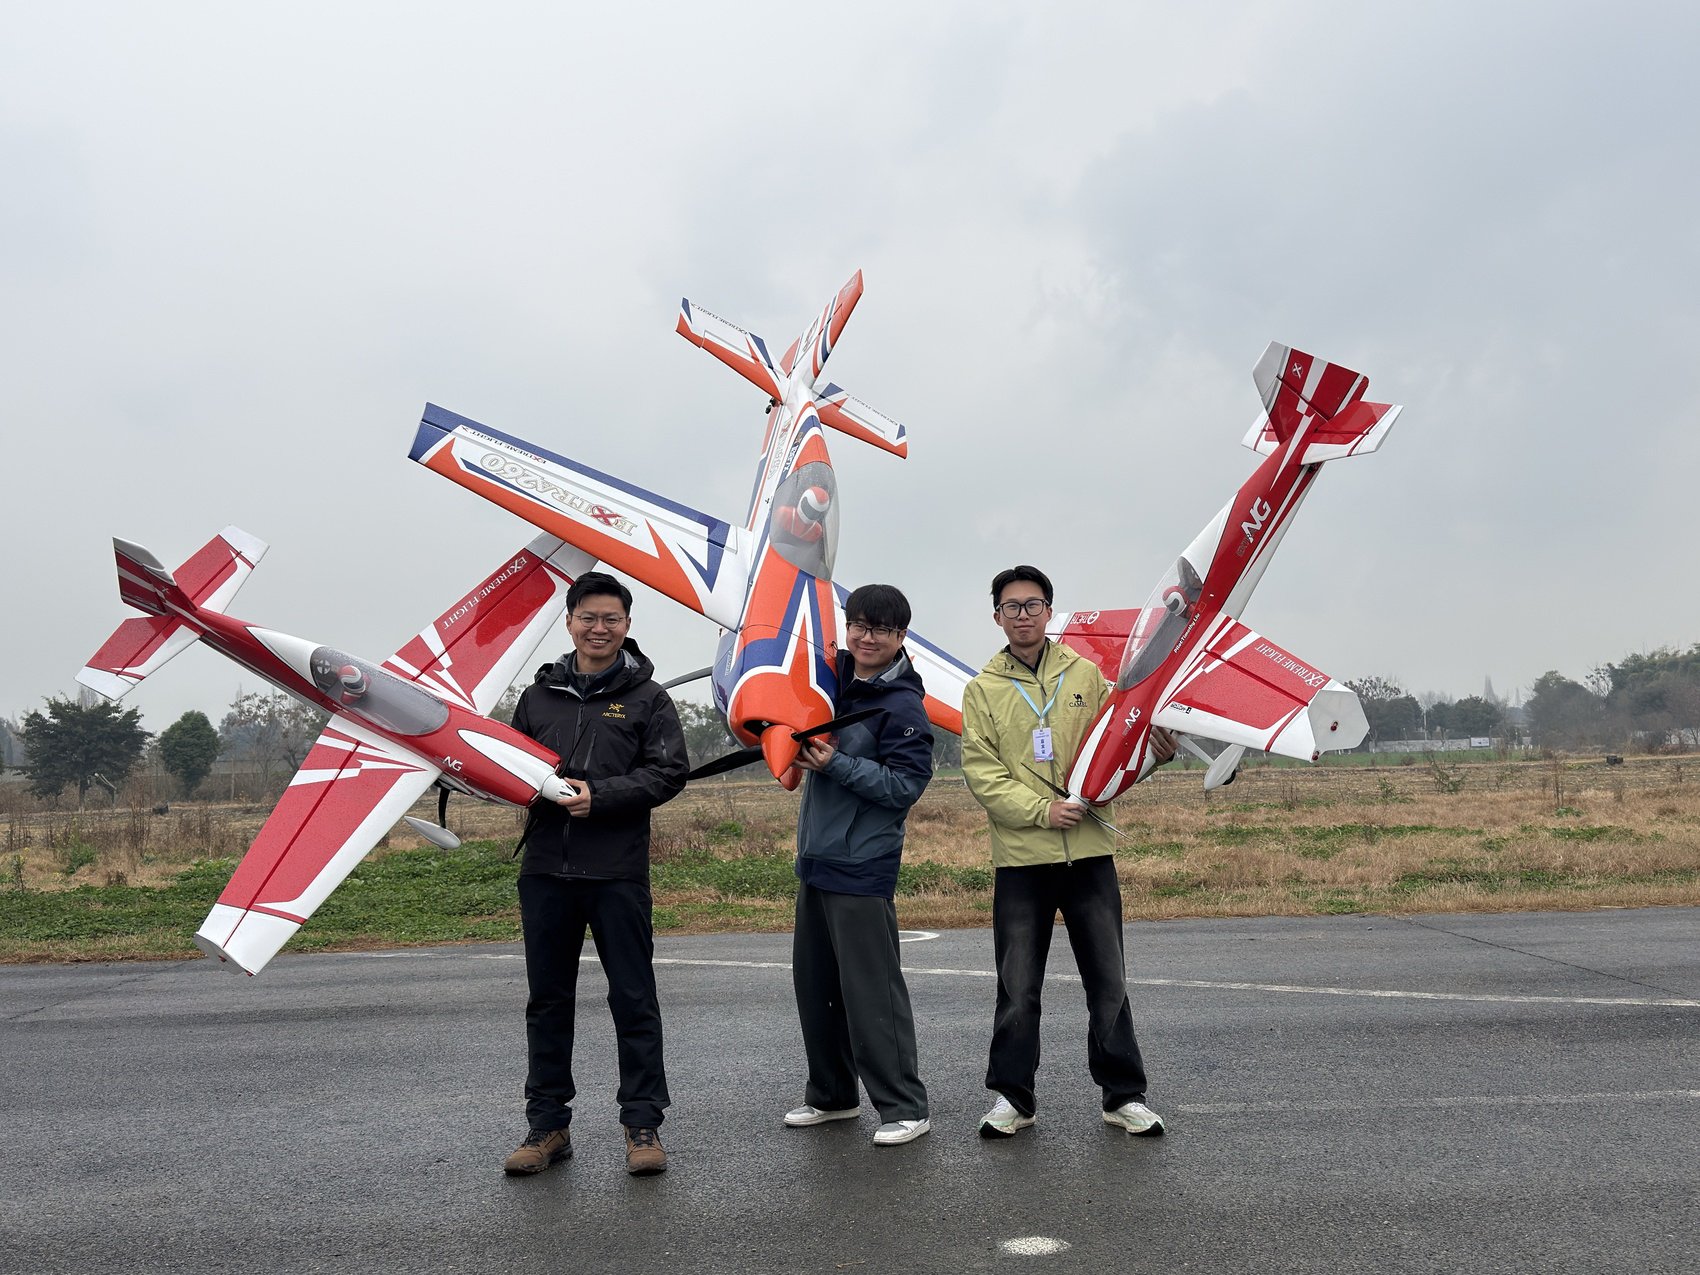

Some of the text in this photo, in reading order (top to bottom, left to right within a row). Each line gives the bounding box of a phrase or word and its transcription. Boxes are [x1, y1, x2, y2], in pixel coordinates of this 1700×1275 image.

[470, 429, 504, 447] FLIGHT
[504, 443, 546, 465] EXTREME
[480, 452, 638, 537] EXTRA260
[1241, 496, 1272, 544] NG
[443, 556, 528, 630] EXTREME FLIGHT
[1255, 643, 1326, 689] EXTREME FLIGHT
[1124, 706, 1142, 729] NG
[442, 755, 464, 772] NG
